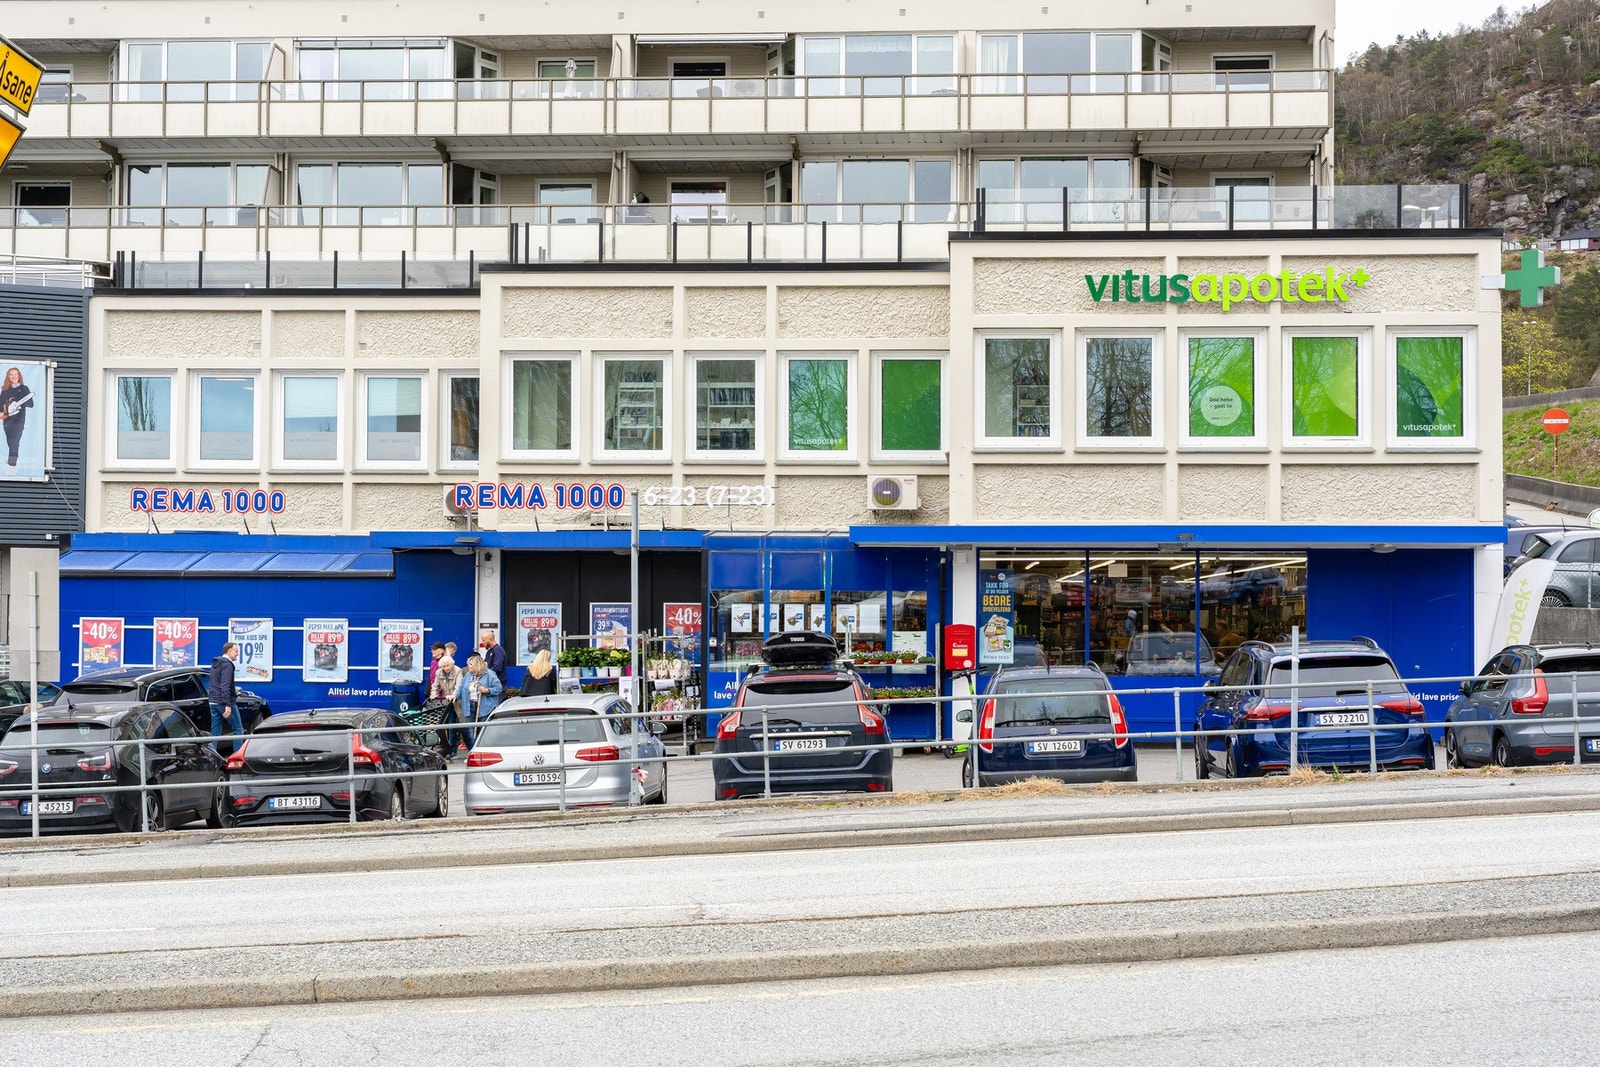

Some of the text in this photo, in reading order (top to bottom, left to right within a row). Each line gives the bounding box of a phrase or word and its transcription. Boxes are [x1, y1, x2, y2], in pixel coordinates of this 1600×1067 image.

[131, 487, 286, 514] REMA 1000
[454, 482, 775, 510] REMA 1000 6-23 (7-23)
[982, 595, 1012, 606] BEDRE
[83, 622, 118, 640] -40%
[158, 621, 193, 639] -40%
[238, 642, 264, 665] 19 90
[328, 687, 350, 696] Alltid
[351, 687, 368, 696] lave
[713, 690, 732, 700] lave
[1322, 713, 1365, 724] SX 22210
[782, 740, 823, 750] SV 61293
[1037, 741, 1078, 751] SV 12602
[522, 774, 533, 783] DS
[44, 802, 71, 811] 45215
[277, 796, 318, 807] BT 43116
